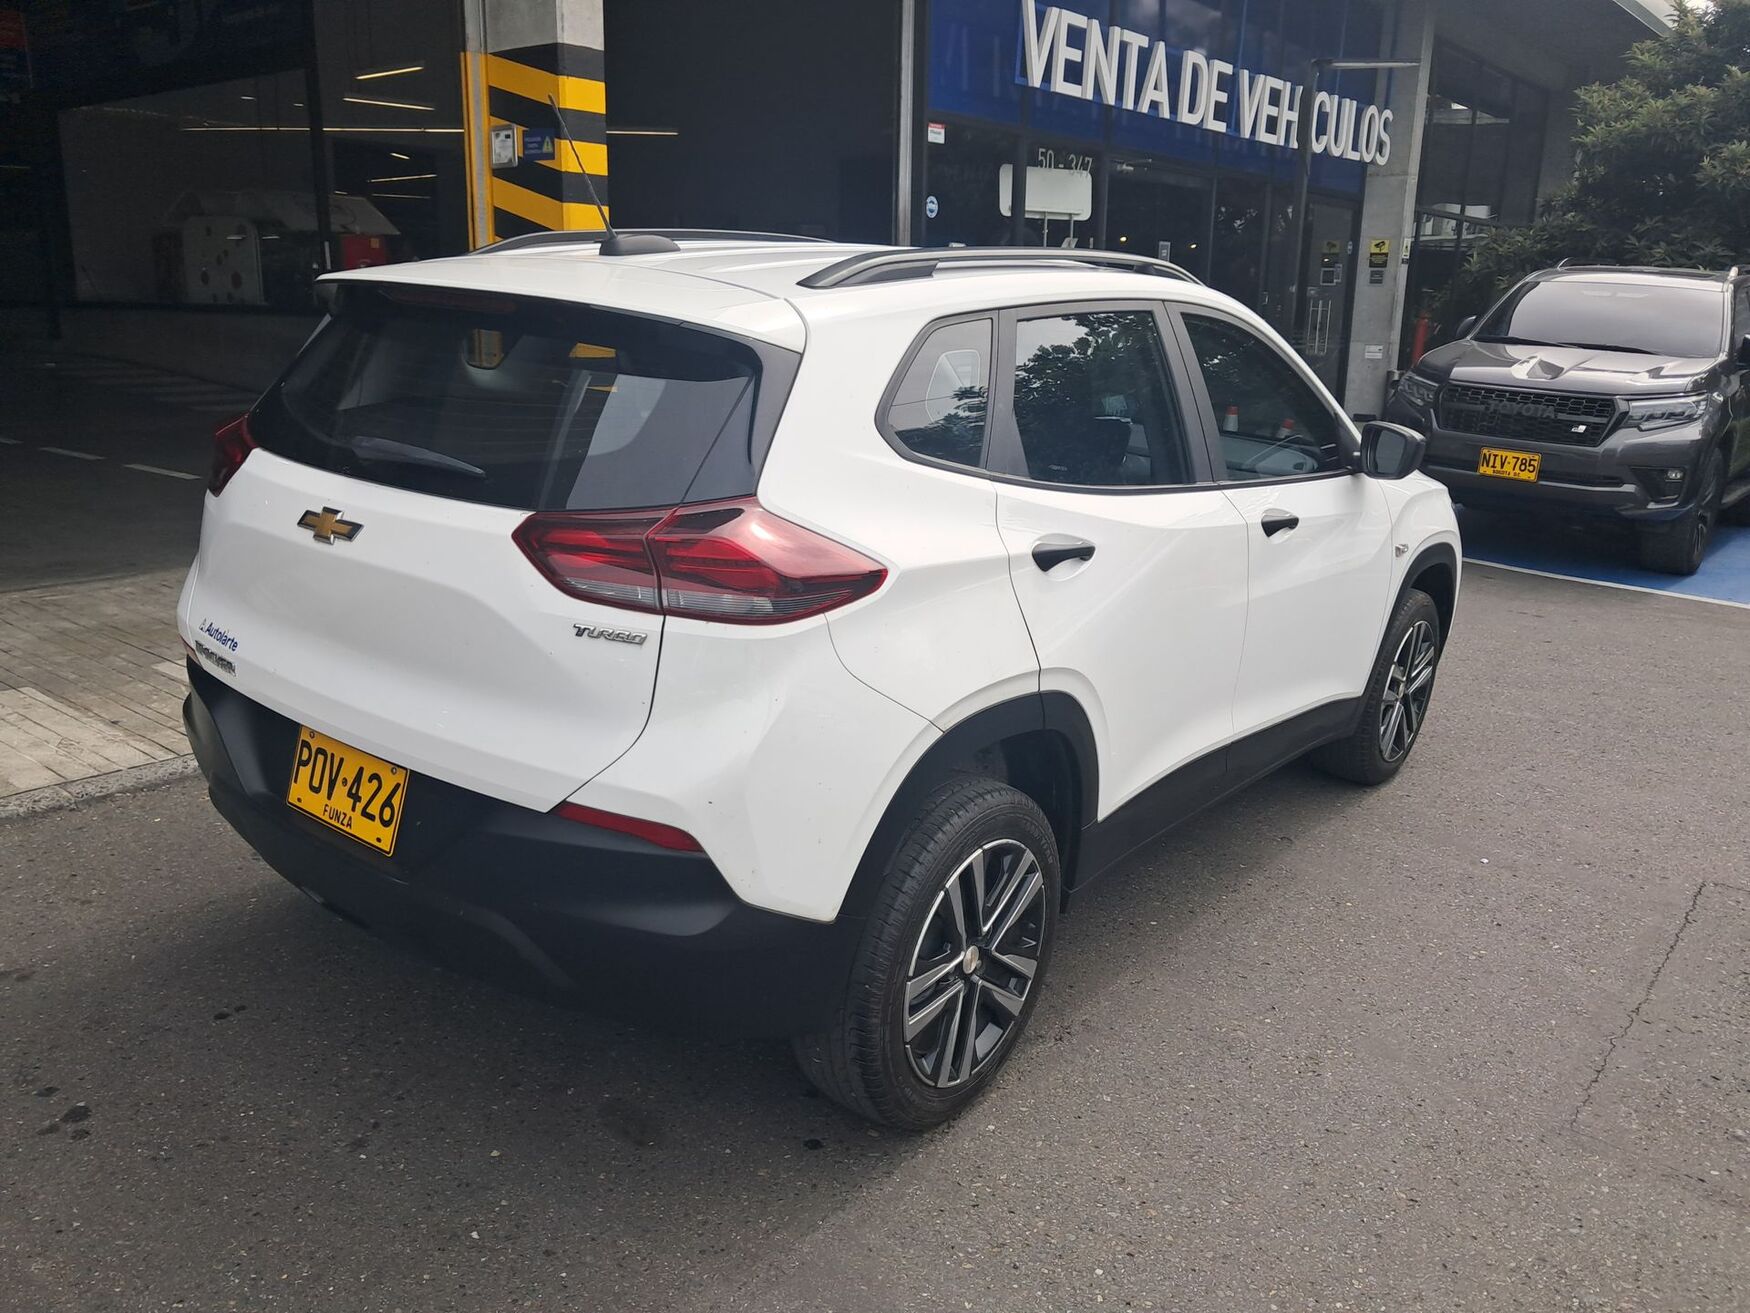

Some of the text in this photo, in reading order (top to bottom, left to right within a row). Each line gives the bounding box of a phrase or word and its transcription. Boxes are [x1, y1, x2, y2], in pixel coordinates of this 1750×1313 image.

[1022, 0, 1394, 166] VENTA DE VEHCULOS
[1038, 147, 1055, 169] 50
[1488, 400, 1556, 419] TOYOTA
[205, 622, 239, 652] Autolarte
[573, 623, 648, 645] TURBO
[322, 803, 353, 830] FUNZA
